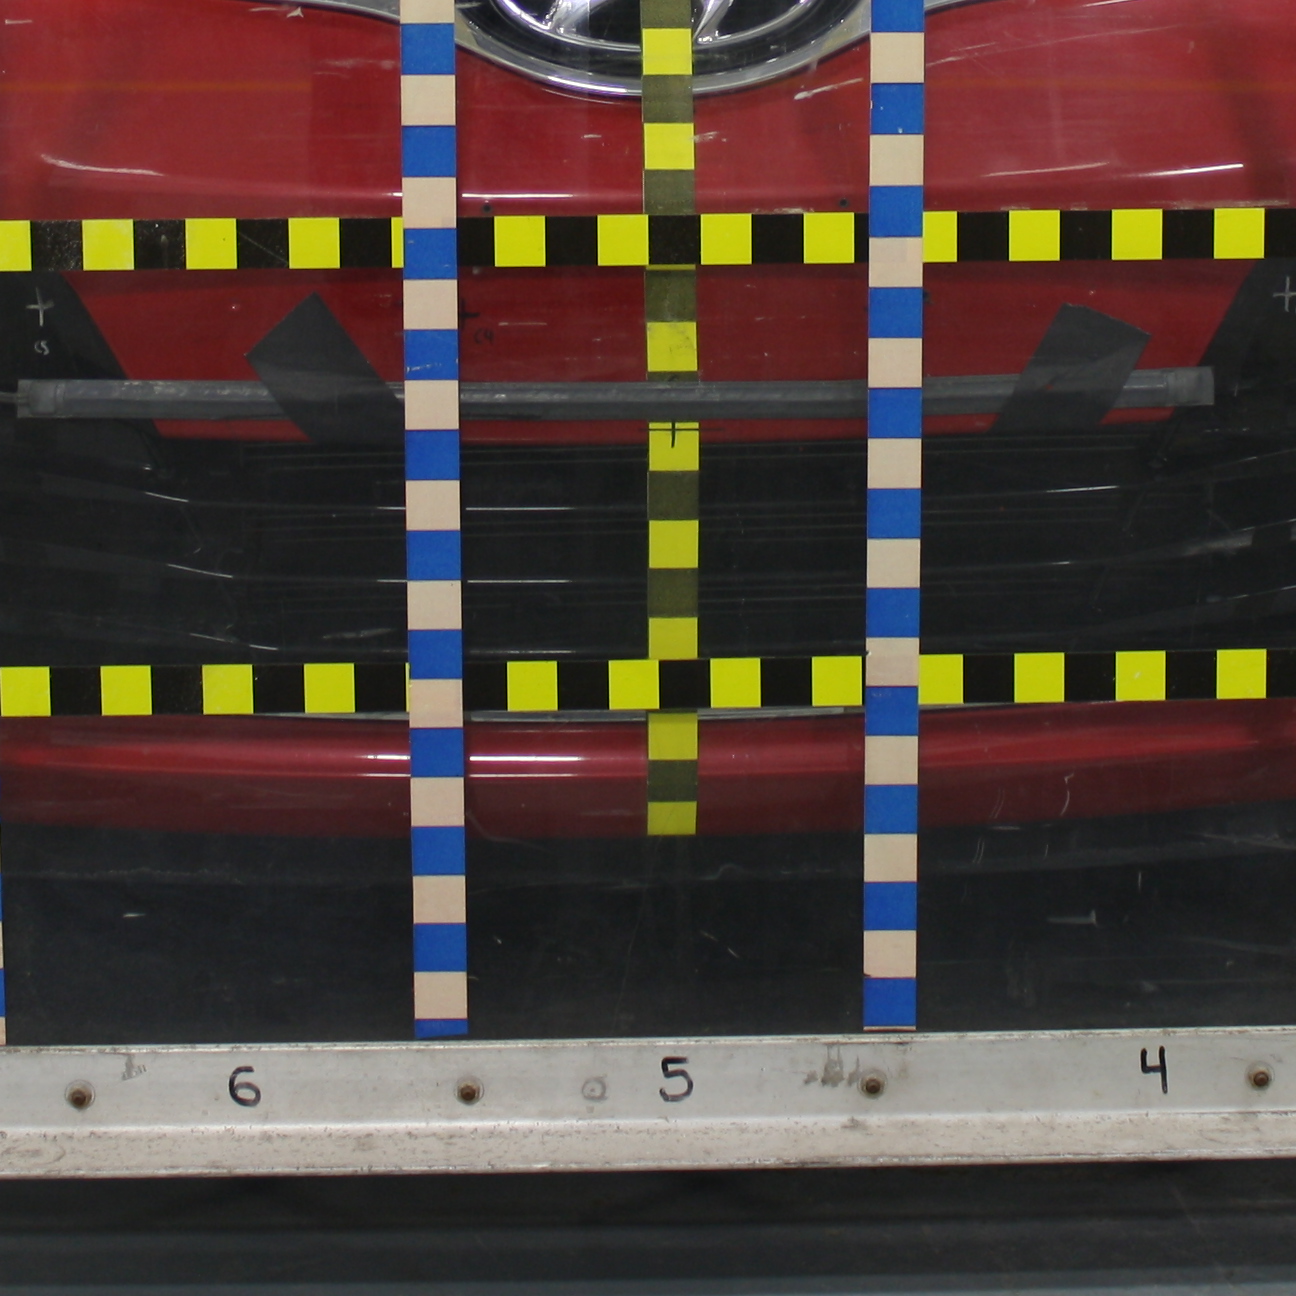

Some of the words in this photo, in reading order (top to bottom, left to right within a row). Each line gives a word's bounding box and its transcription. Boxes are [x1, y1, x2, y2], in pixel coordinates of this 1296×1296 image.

[228, 1066, 261, 1107] 6
[659, 1056, 693, 1102] 5
[1140, 1046, 1168, 1094] 4
